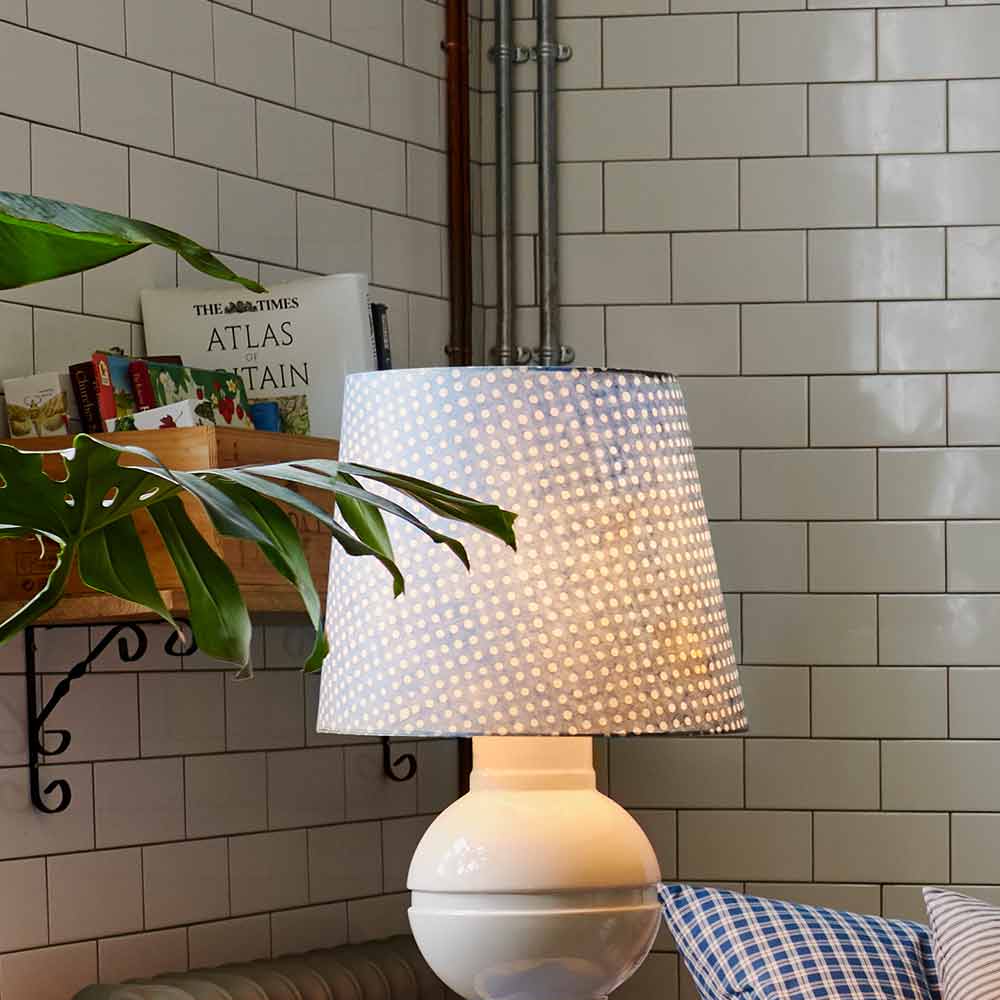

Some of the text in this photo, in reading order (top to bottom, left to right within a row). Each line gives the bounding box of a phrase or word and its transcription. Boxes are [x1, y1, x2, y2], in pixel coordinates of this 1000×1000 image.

[193, 297, 299, 316] THE TIMES
[208, 321, 294, 351] ATLAS
[216, 362, 309, 390] TAIN
